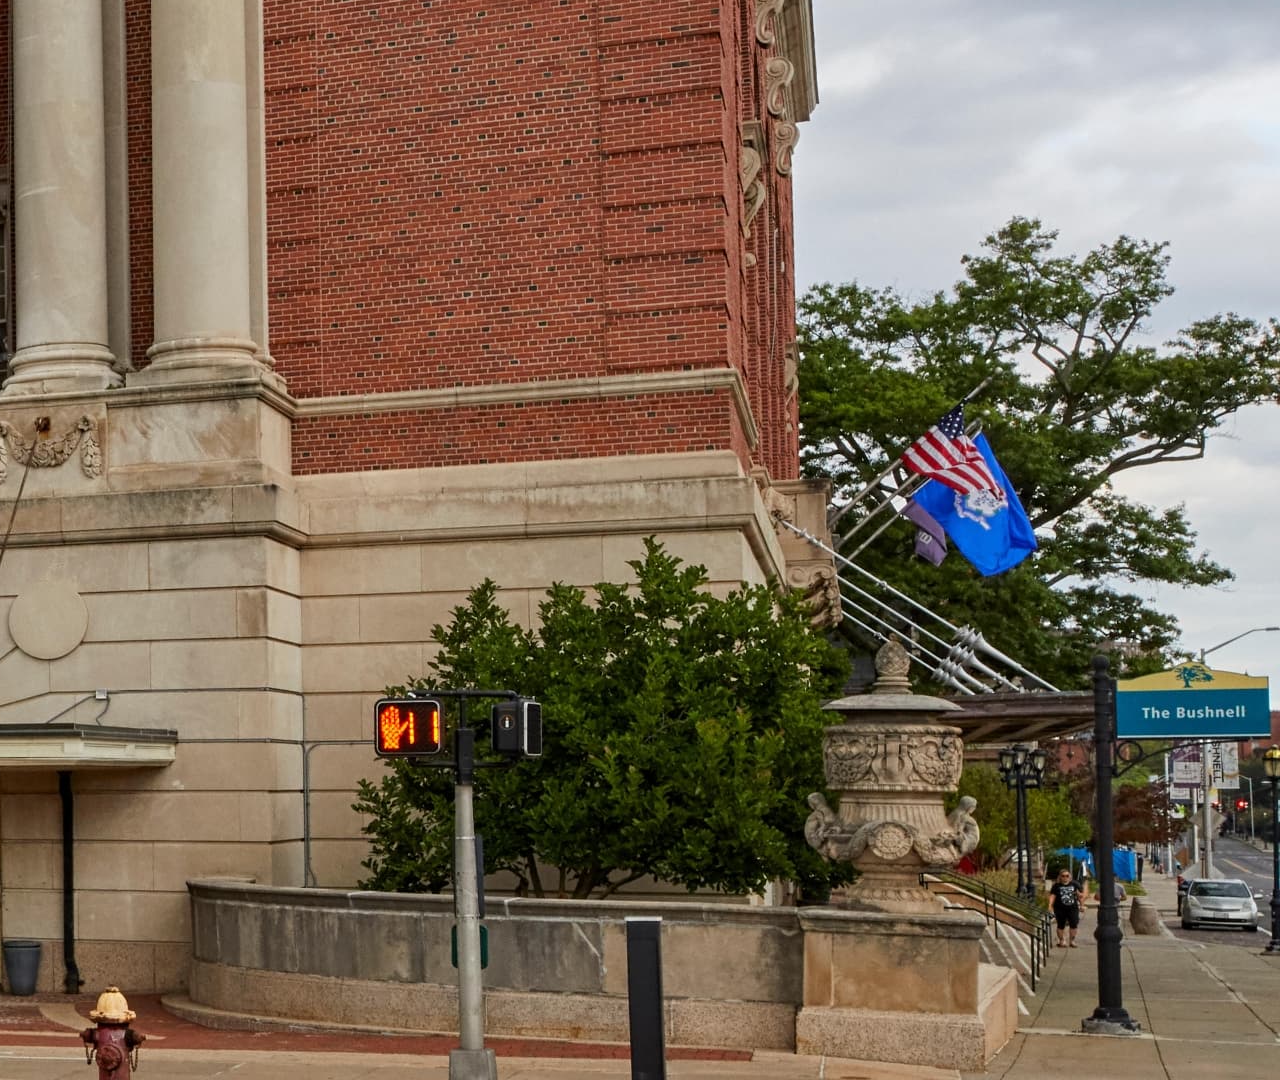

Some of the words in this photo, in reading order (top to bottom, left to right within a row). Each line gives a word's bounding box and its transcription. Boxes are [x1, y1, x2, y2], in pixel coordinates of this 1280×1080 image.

[1142, 706, 1170, 719] The
[1176, 705, 1246, 719] Bushnell
[408, 710, 439, 745] 11
